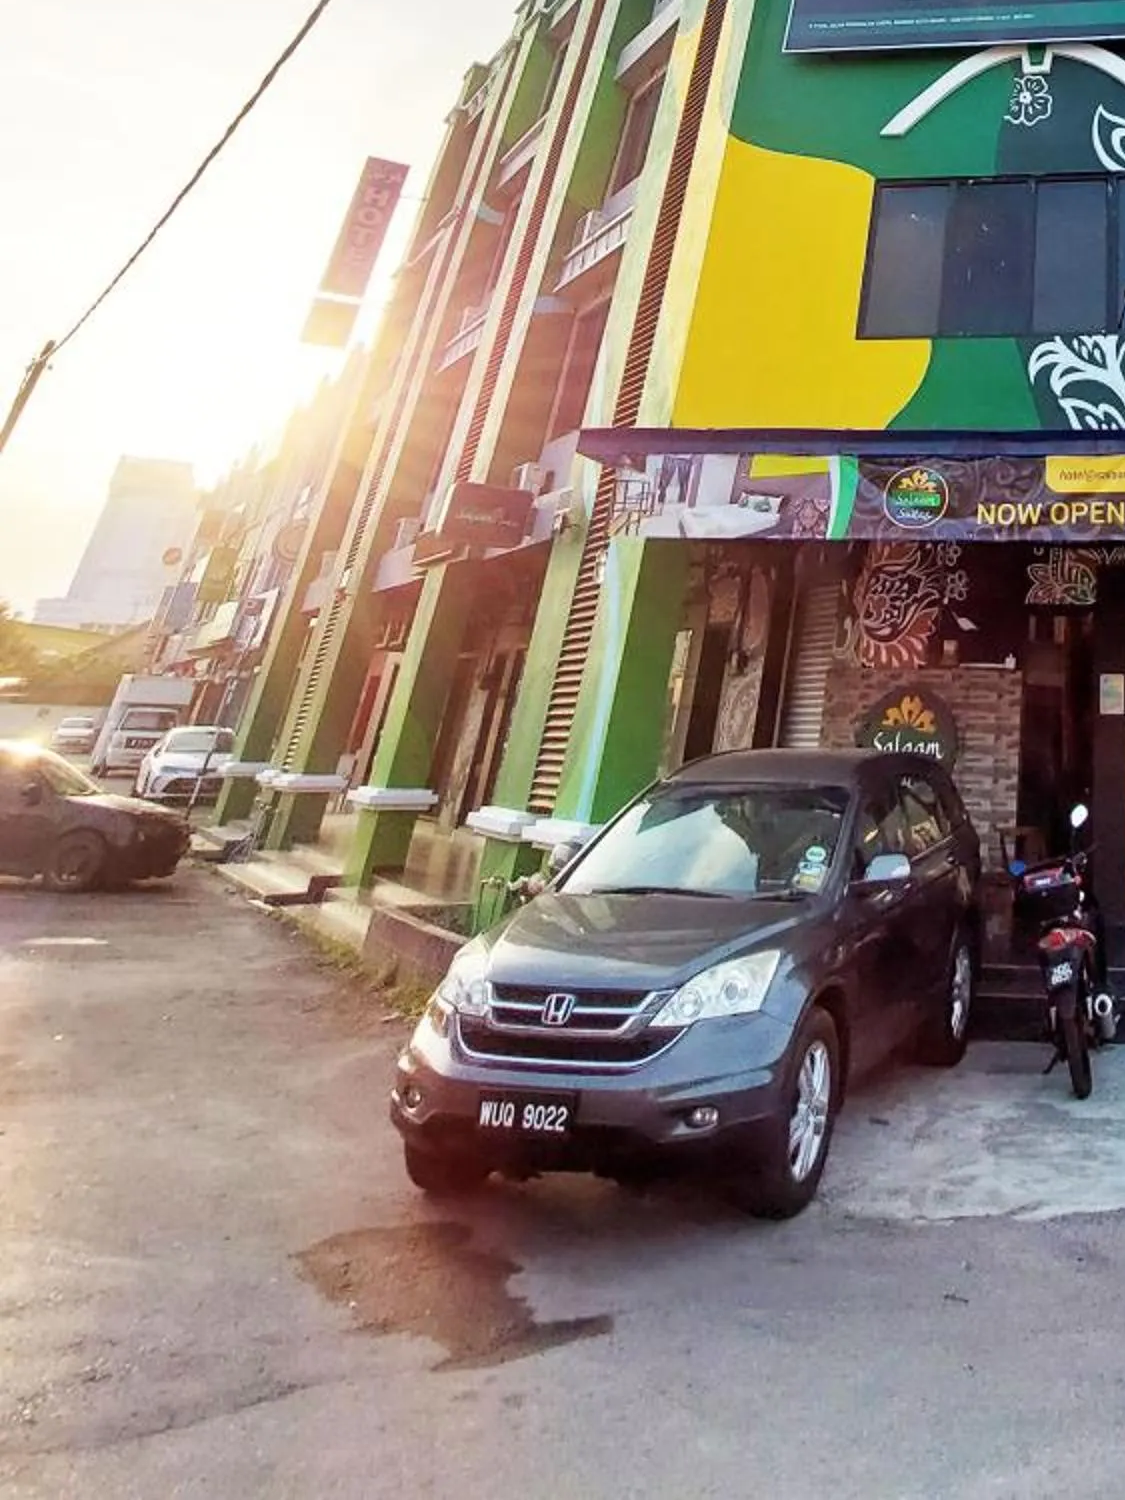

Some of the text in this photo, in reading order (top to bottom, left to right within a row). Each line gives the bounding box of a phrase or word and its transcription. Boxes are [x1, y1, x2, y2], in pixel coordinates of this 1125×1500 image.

[976, 502, 1043, 526] NOW
[1050, 501, 1125, 526] OPEN
[873, 731, 945, 760] Salaam
[480, 1100, 569, 1132] WUQ 9022
